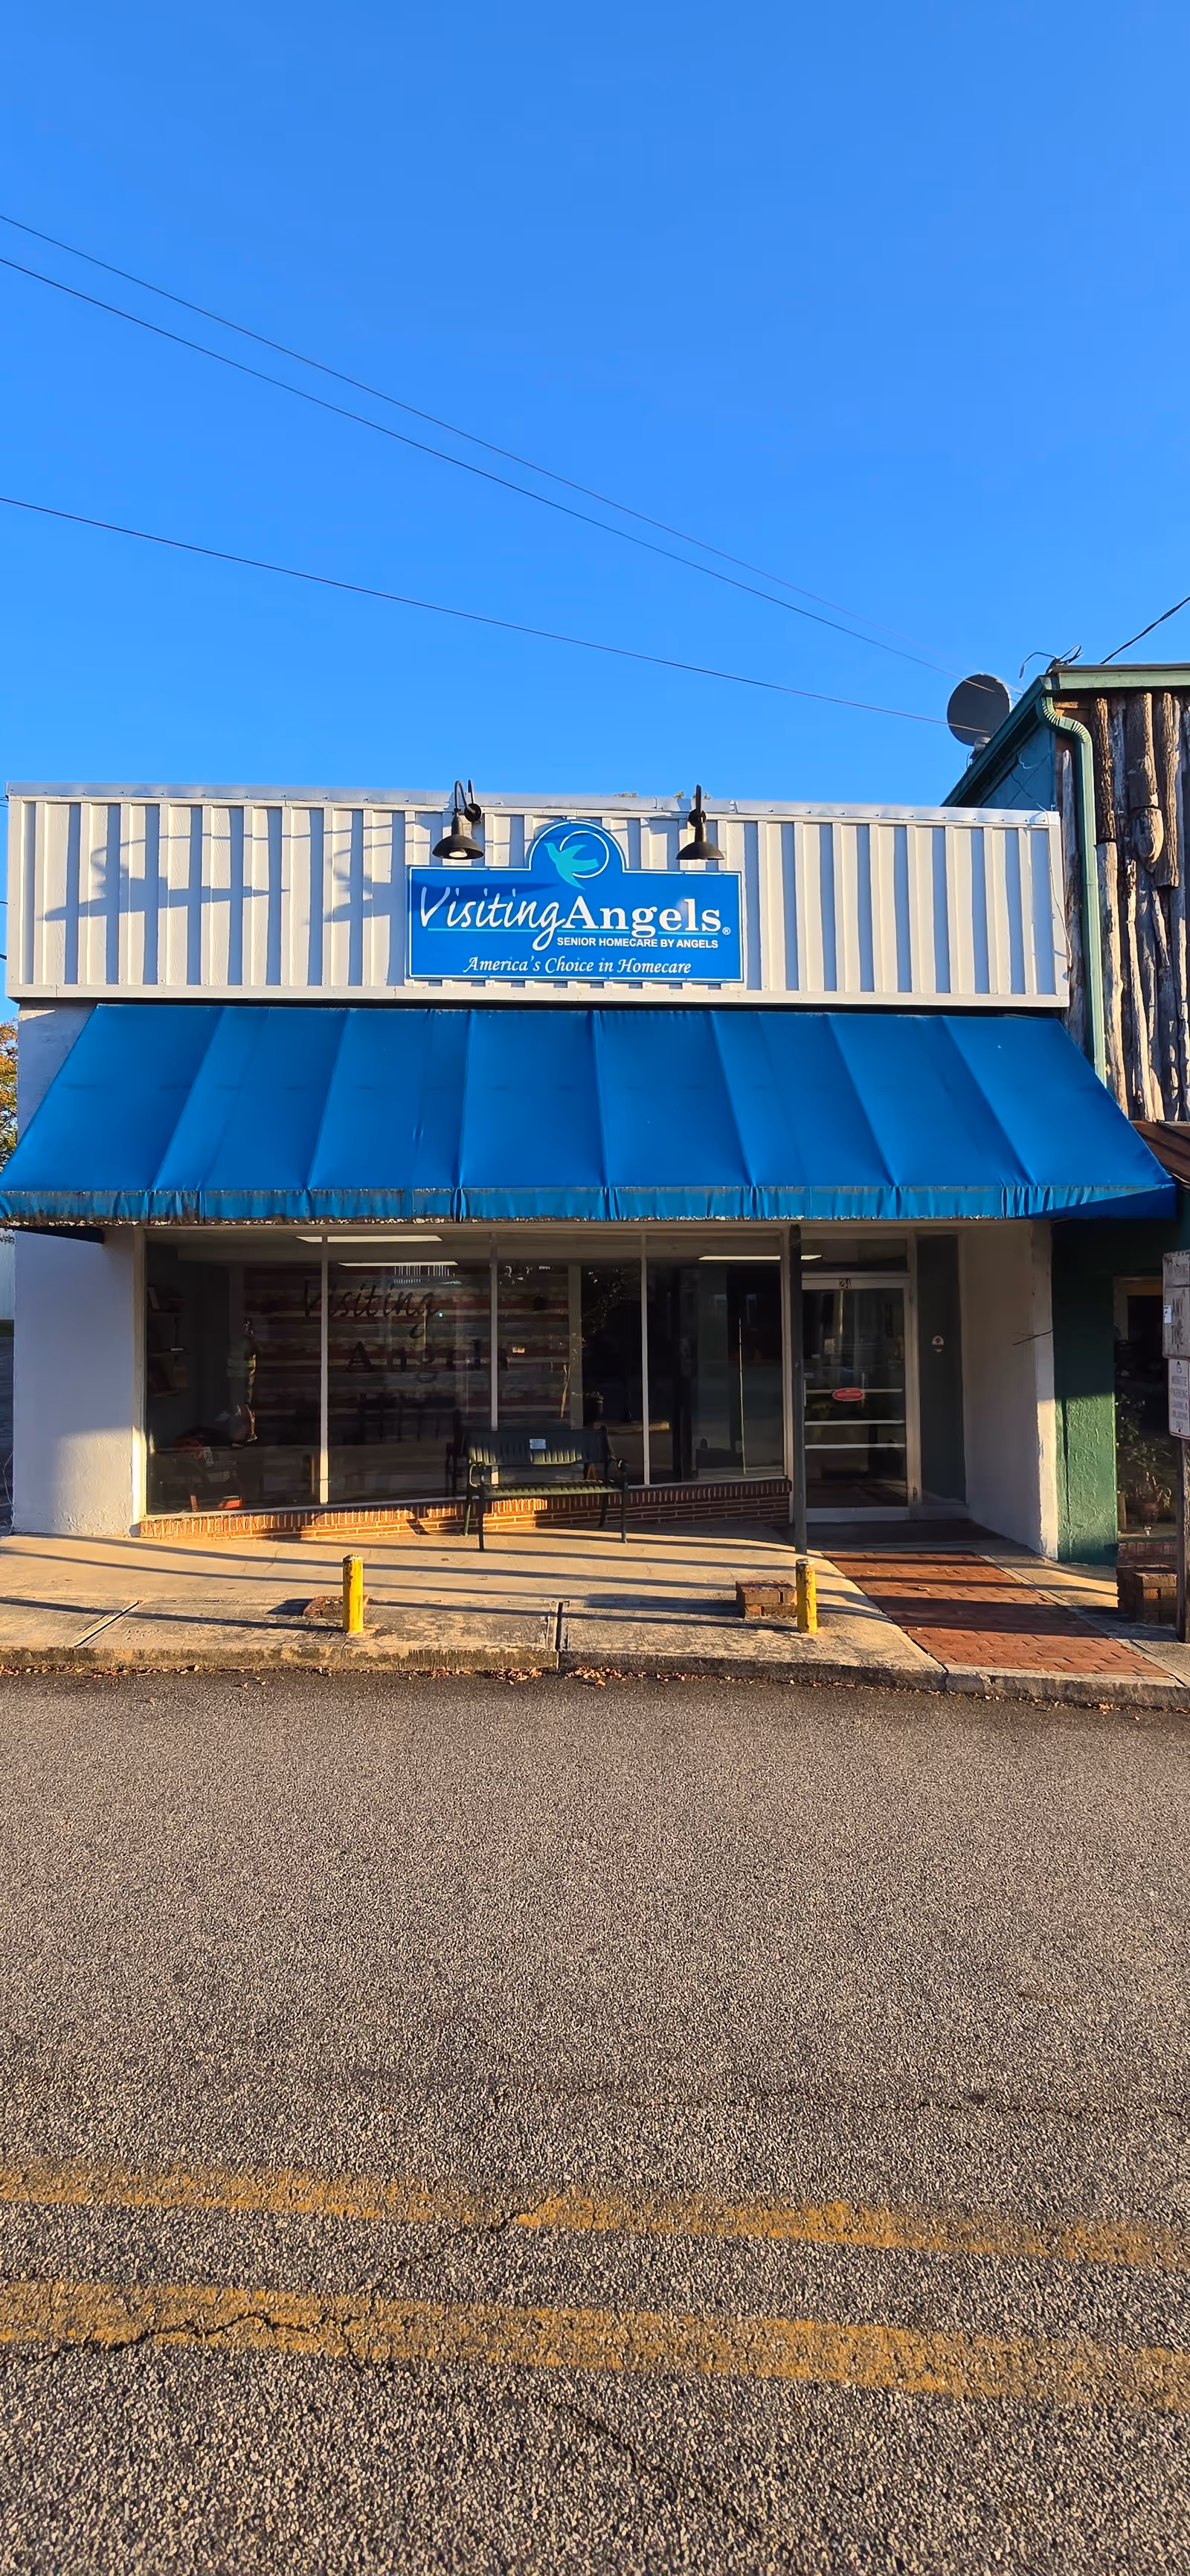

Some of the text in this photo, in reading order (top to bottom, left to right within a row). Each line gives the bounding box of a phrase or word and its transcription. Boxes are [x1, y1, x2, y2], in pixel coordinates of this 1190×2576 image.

[420, 886, 566, 951] Visiting
[557, 937, 718, 949] SENIOR HOMECARE BY ANGELS
[463, 955, 692, 974] America's Choice in Homecare
[303, 1279, 442, 1340] Visiting
